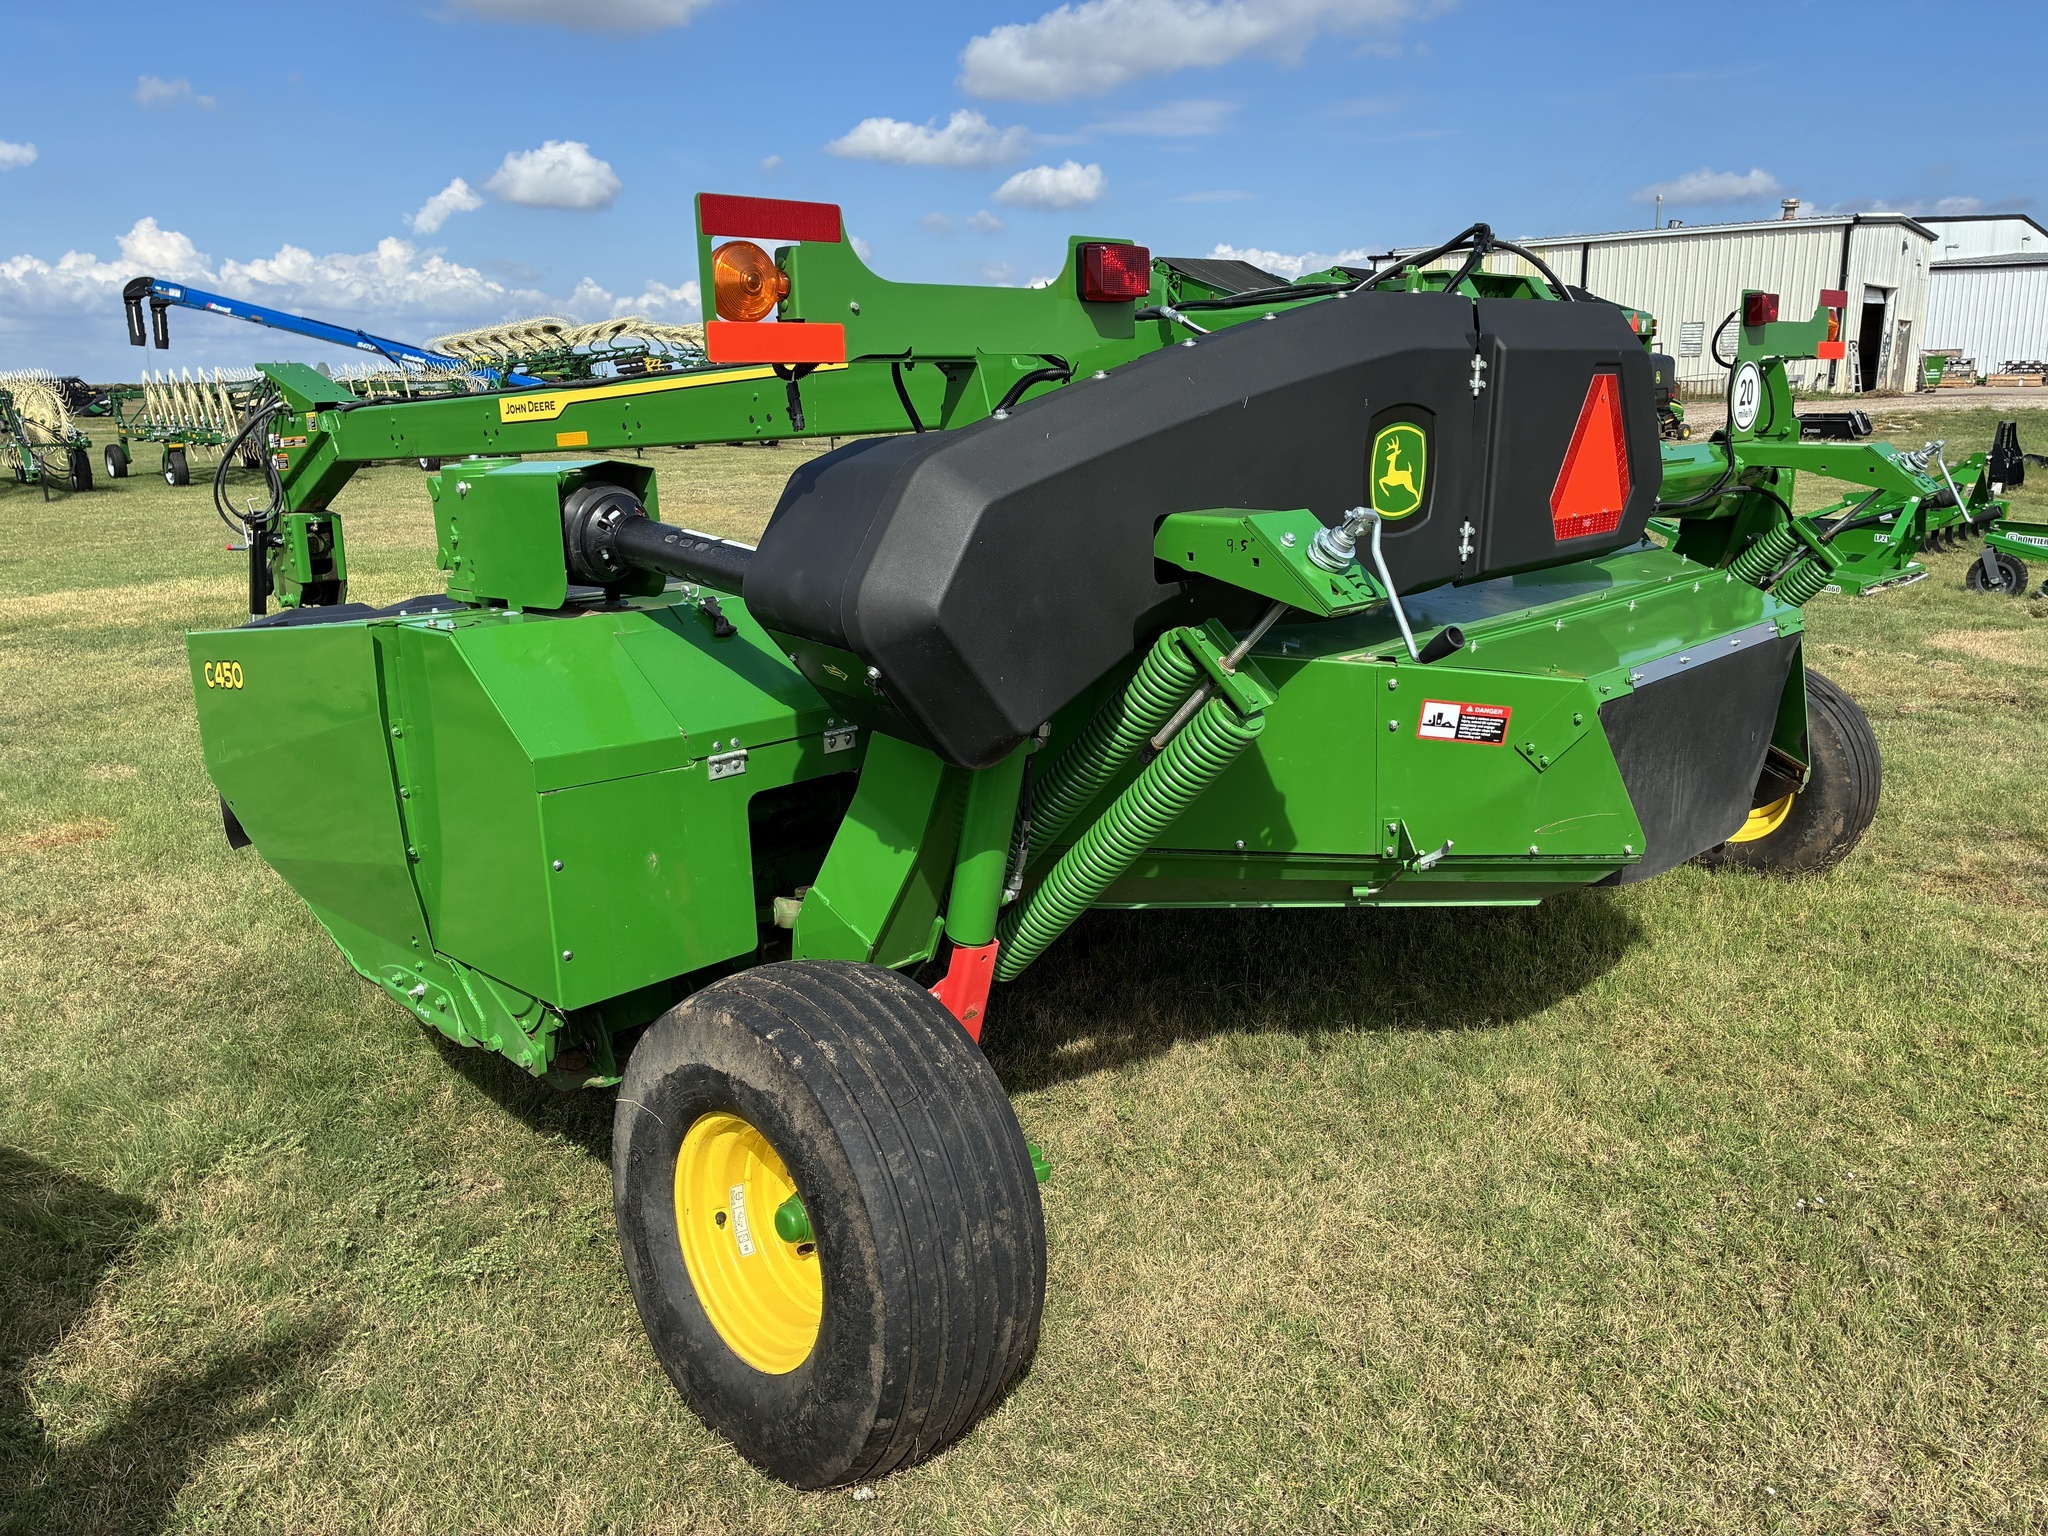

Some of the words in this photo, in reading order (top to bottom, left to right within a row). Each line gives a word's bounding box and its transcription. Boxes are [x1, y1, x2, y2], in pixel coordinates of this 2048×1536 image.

[1739, 378, 1754, 406] 20
[505, 402, 527, 415] JOHN
[527, 400, 556, 412] DEERE
[205, 660, 244, 690] C450
[1474, 707, 1504, 715] DANGER
